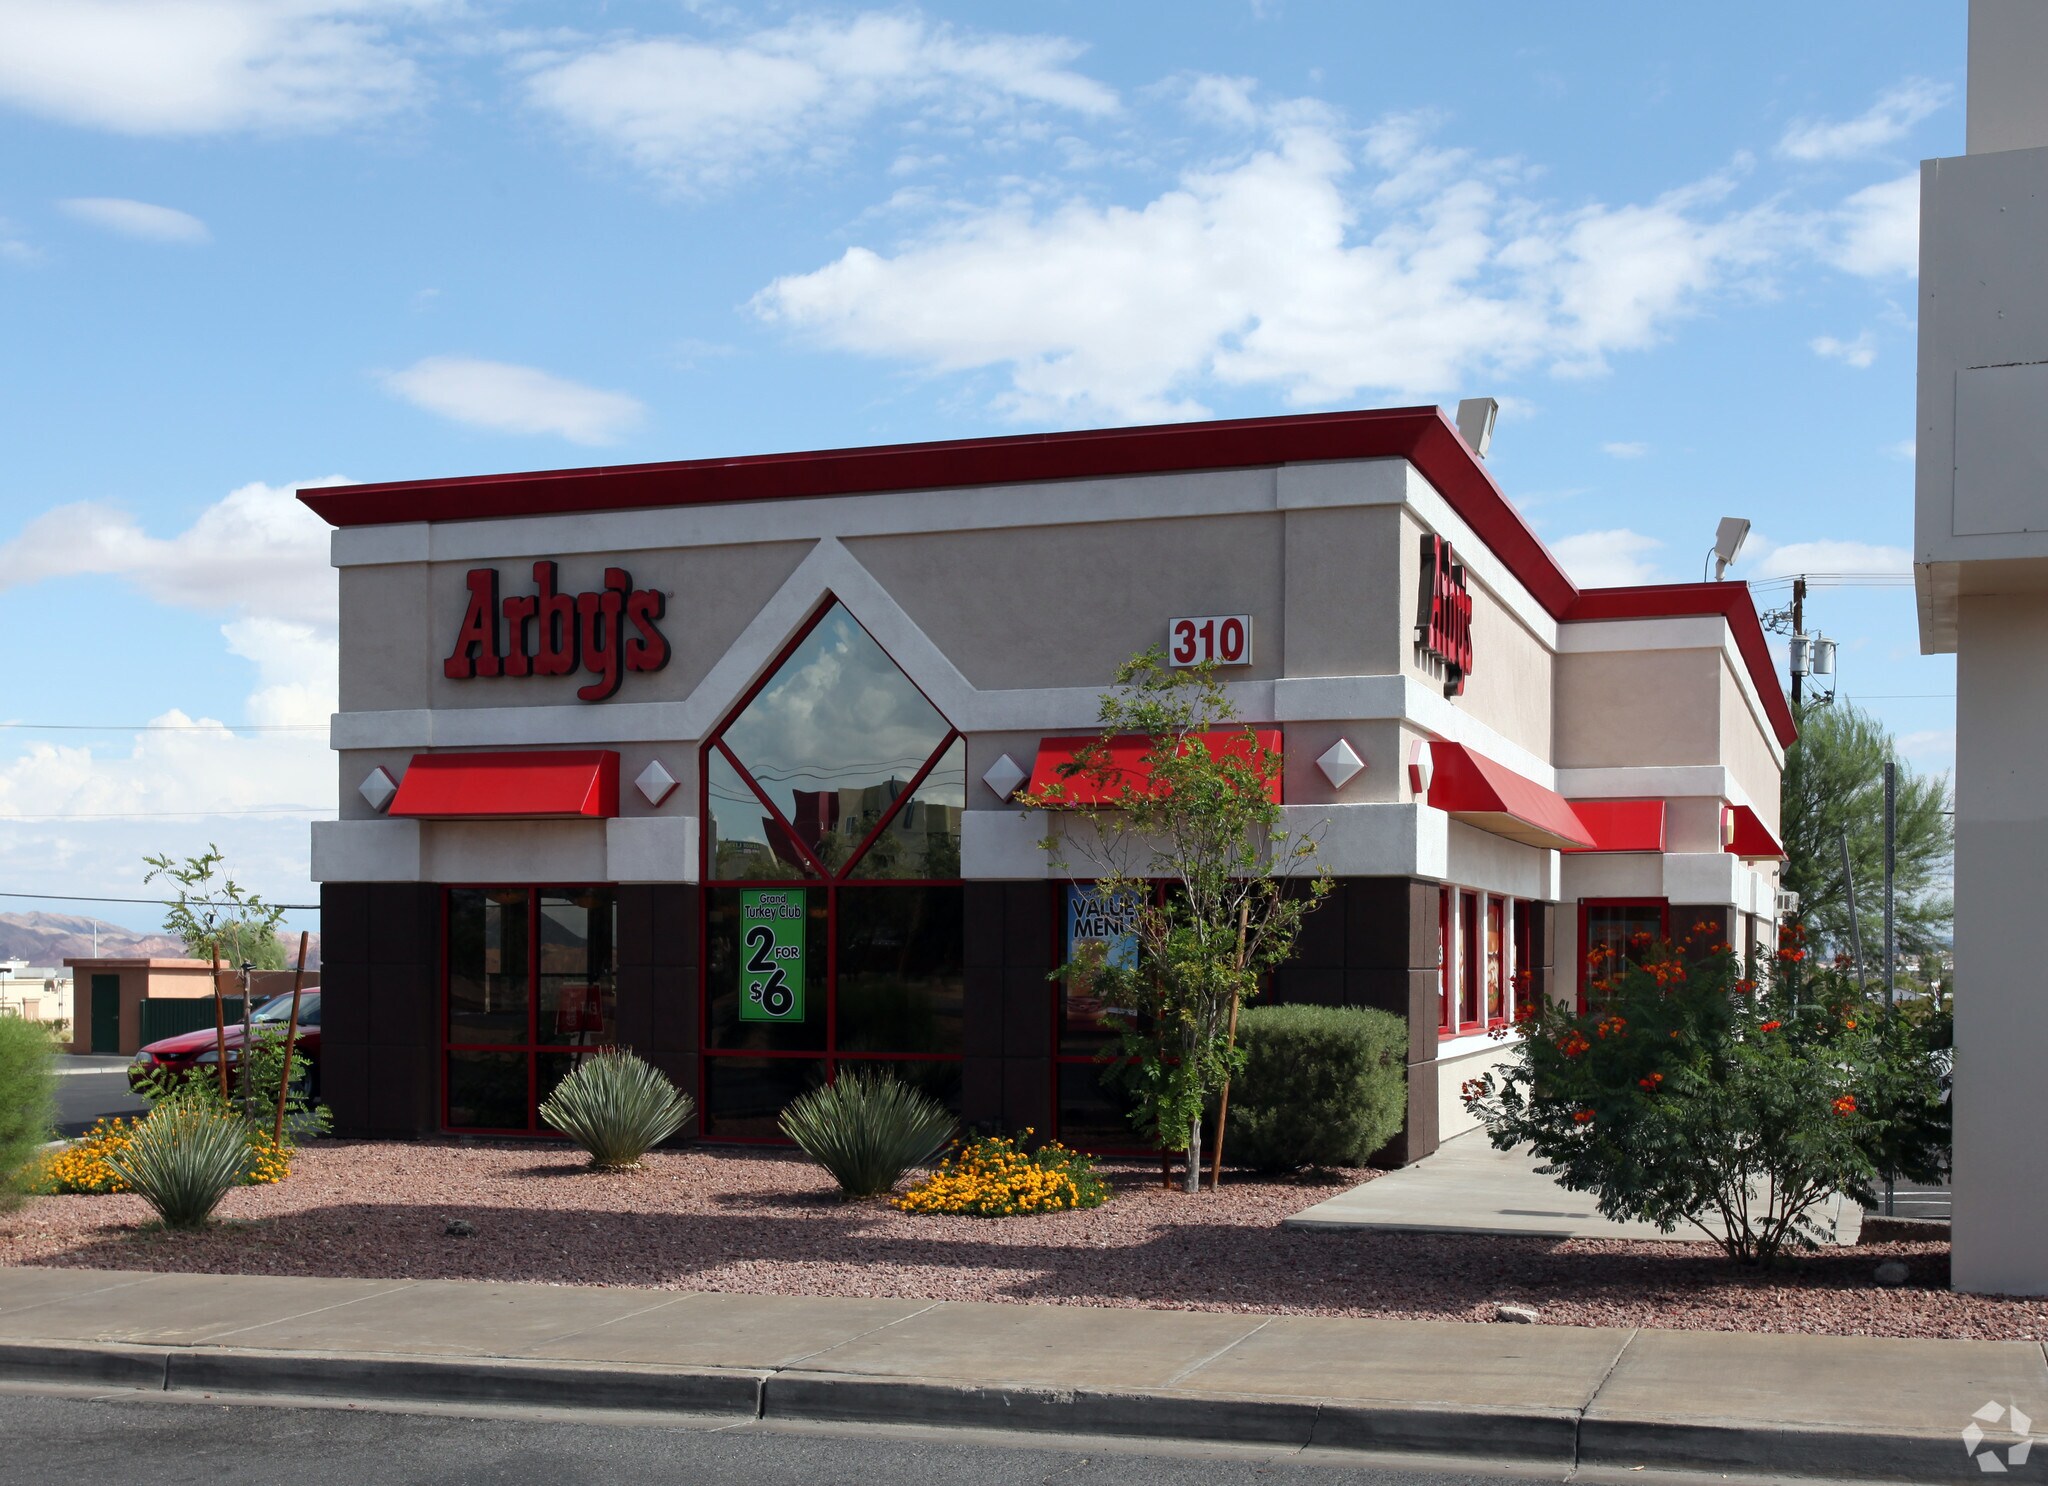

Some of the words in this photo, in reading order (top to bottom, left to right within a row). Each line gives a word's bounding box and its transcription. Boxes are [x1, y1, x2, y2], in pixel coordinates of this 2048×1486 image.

[444, 560, 671, 701] Arby's
[1173, 617, 1244, 663] 310
[744, 905, 777, 921] Turkey
[778, 904, 801, 918] Club
[759, 893, 787, 904] Grand
[1071, 897, 1135, 918] VALUE
[745, 925, 778, 973] 2
[775, 946, 800, 959] FOR
